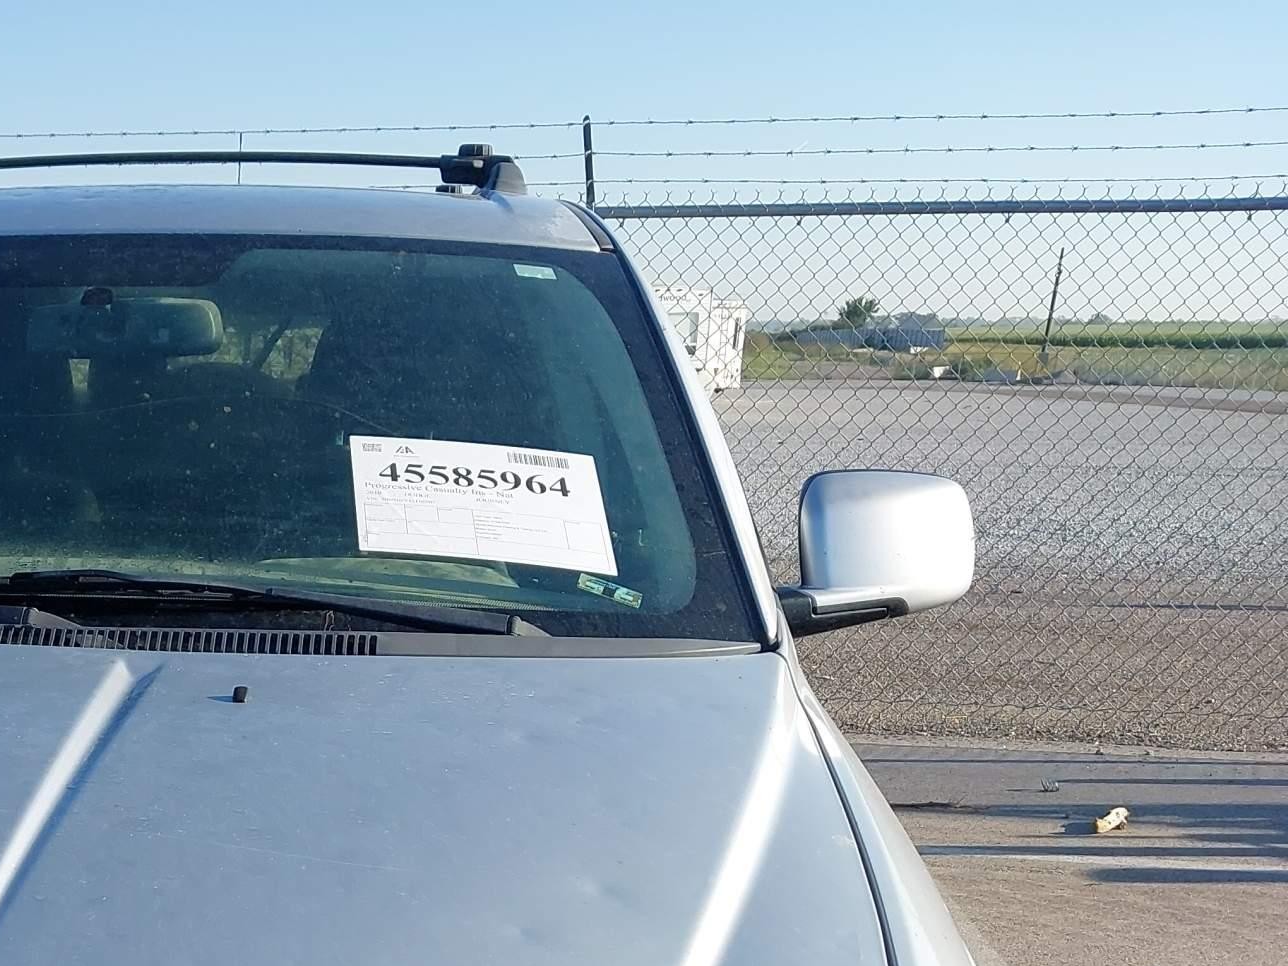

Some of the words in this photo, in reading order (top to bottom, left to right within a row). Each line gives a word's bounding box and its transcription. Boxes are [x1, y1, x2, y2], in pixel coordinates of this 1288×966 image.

[364, 481, 423, 492] Progressive
[424, 485, 469, 496] Casualty
[378, 461, 571, 498] 45585964
